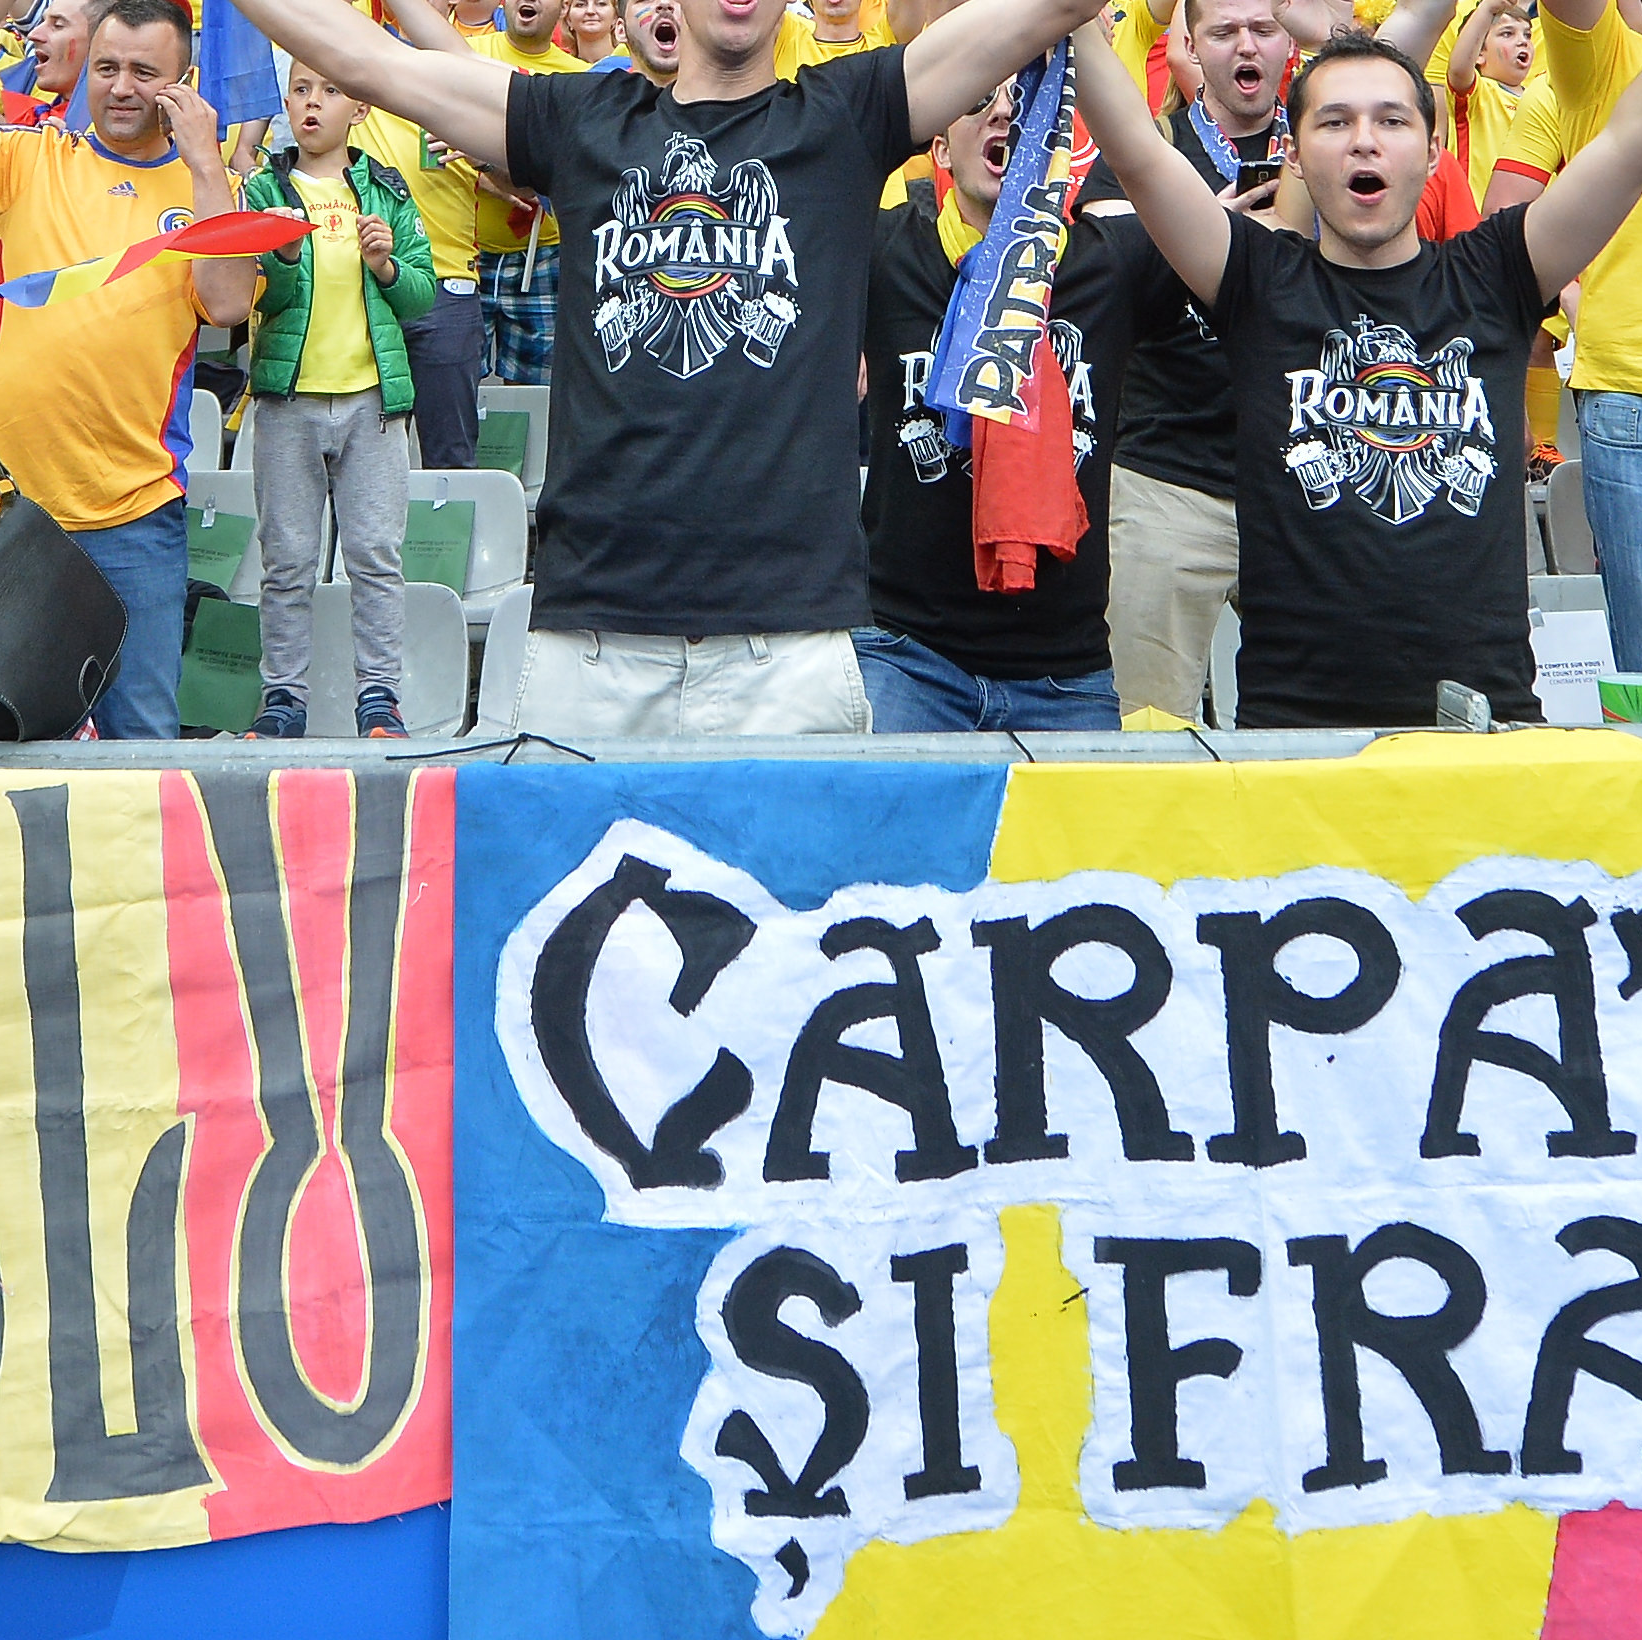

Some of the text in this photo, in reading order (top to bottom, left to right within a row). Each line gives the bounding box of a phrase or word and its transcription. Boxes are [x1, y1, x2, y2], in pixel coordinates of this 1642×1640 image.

[591, 215, 799, 293] ROMÂNIA
[956, 182, 1068, 416] PATRIA
[1284, 368, 1497, 446] ROMÂNIA
